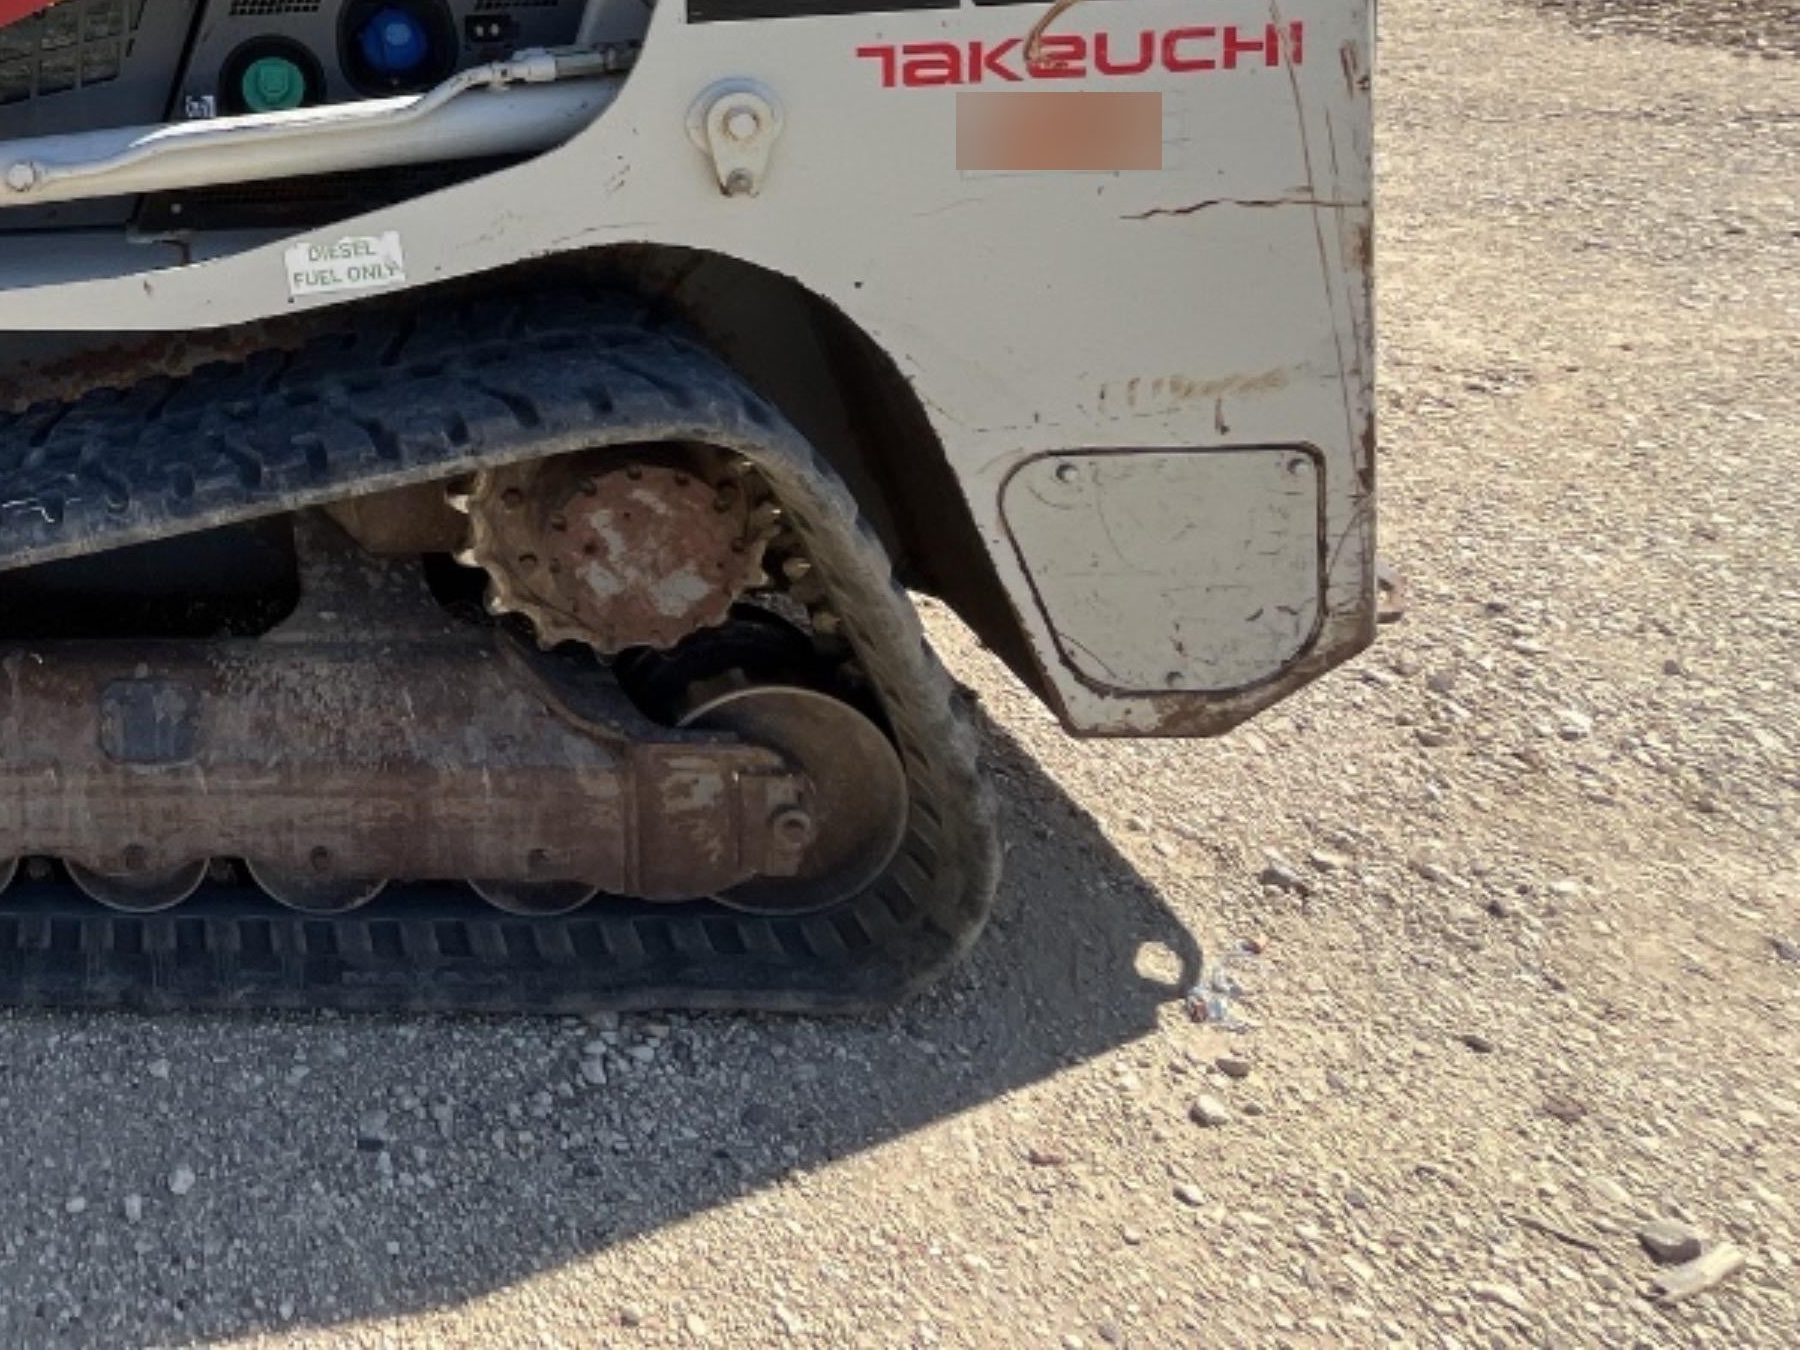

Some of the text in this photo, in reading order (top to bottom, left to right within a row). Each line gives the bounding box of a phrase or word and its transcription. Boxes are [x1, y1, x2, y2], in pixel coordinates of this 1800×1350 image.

[308, 241, 376, 262] DIESEL
[294, 261, 399, 286] FUEL ONLY
